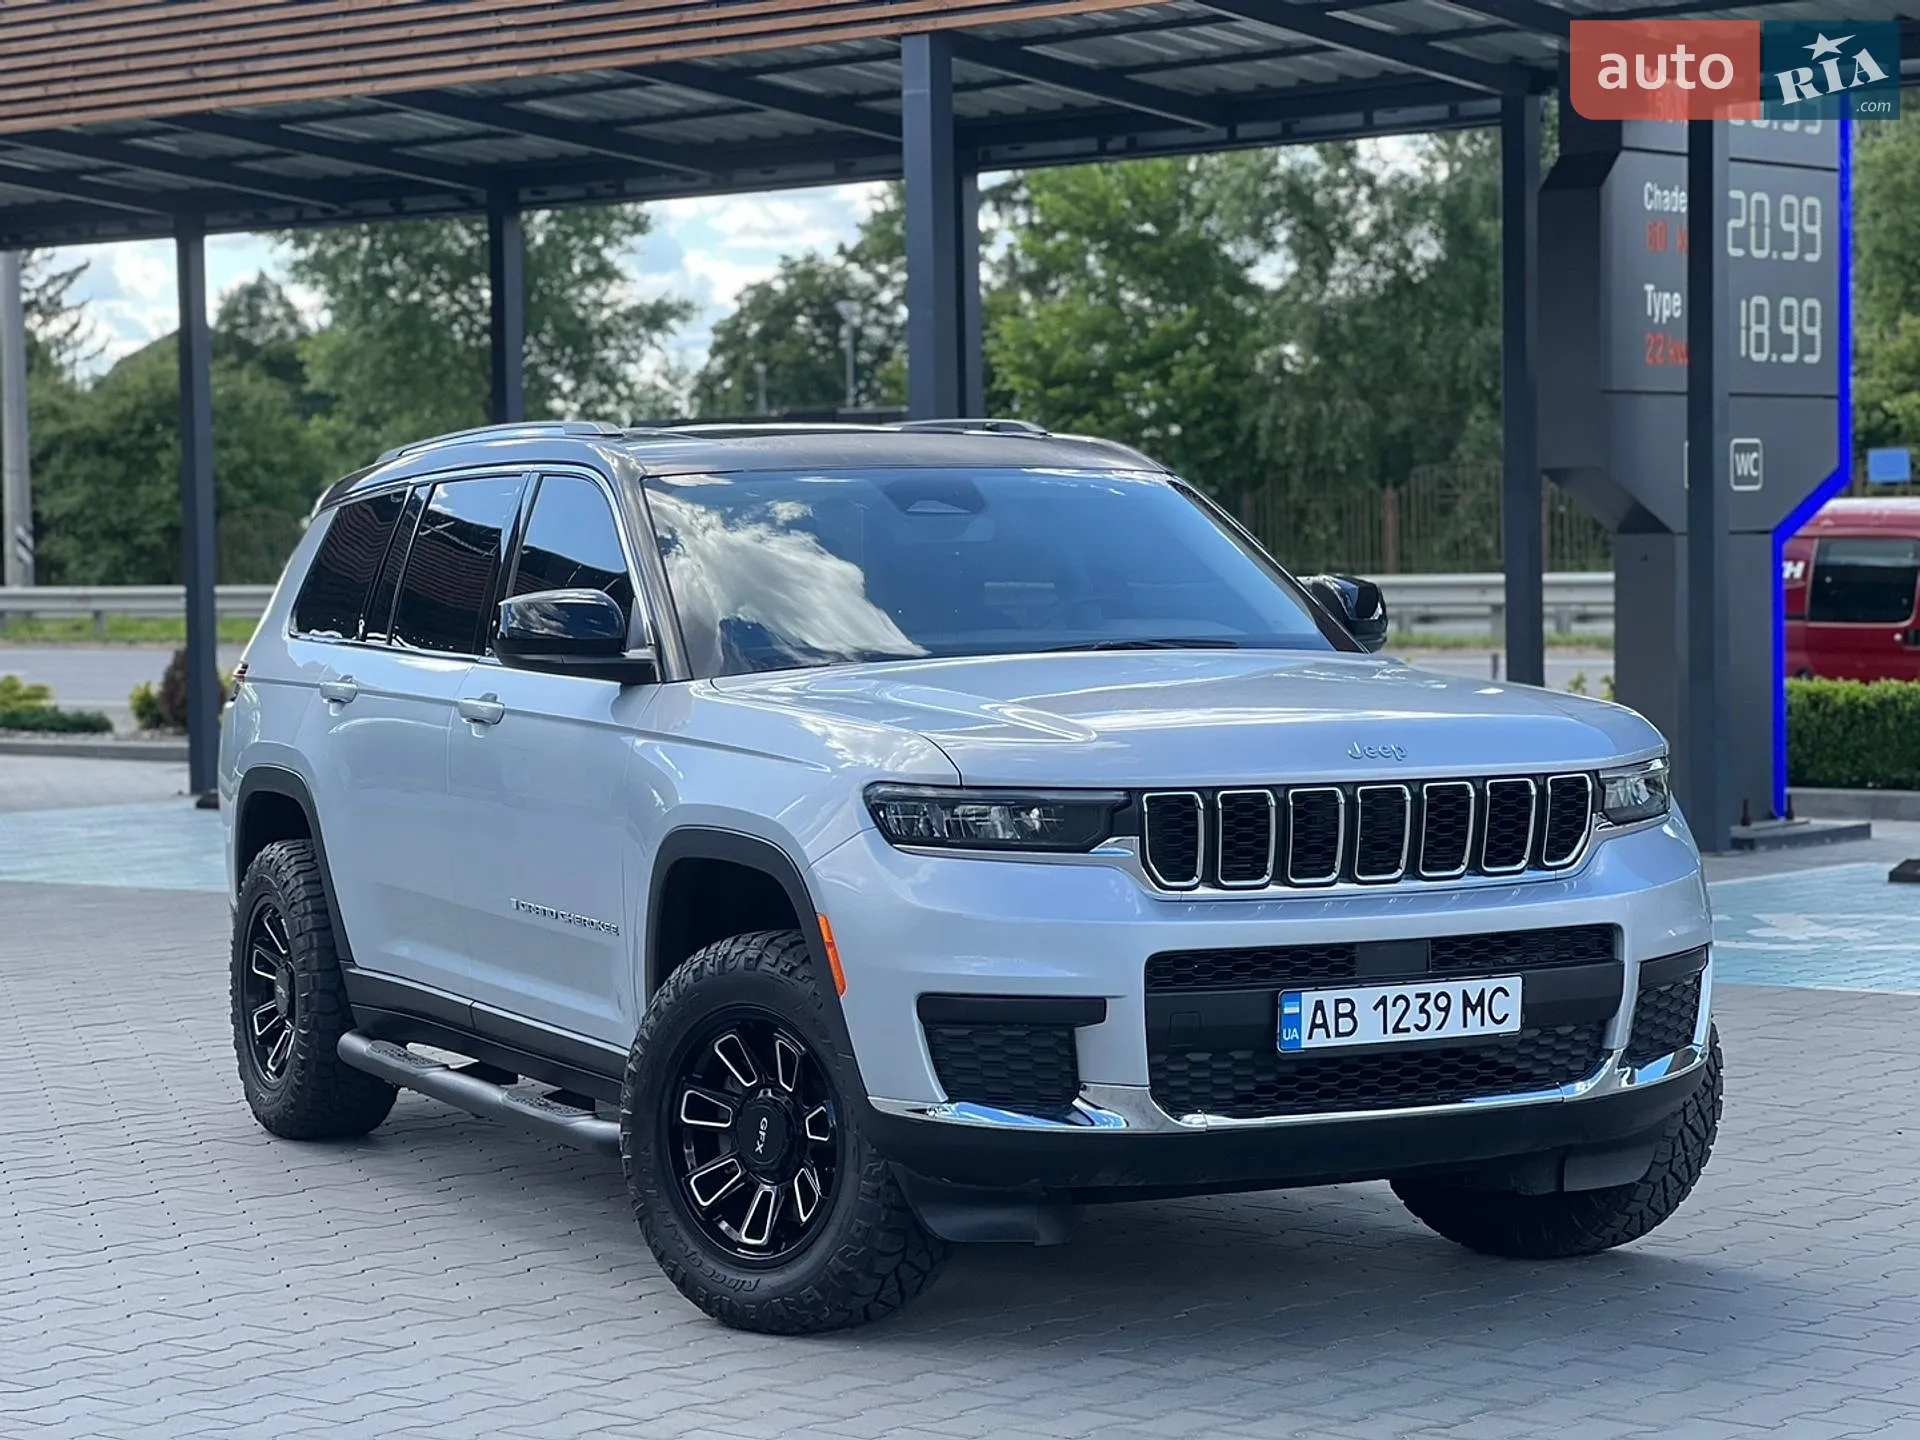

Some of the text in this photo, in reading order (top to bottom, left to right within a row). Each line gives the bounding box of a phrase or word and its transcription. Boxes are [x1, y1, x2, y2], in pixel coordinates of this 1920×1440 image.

[1727, 189, 1822, 262] 20.99
[1643, 284, 1682, 324] Type
[1740, 295, 1821, 364] 18.99
[1735, 452, 1758, 476] WC
[1347, 740, 1408, 762] Jeep
[1307, 986, 1510, 1040] AB 1239 MC
[1283, 1027, 1299, 1041] UA
